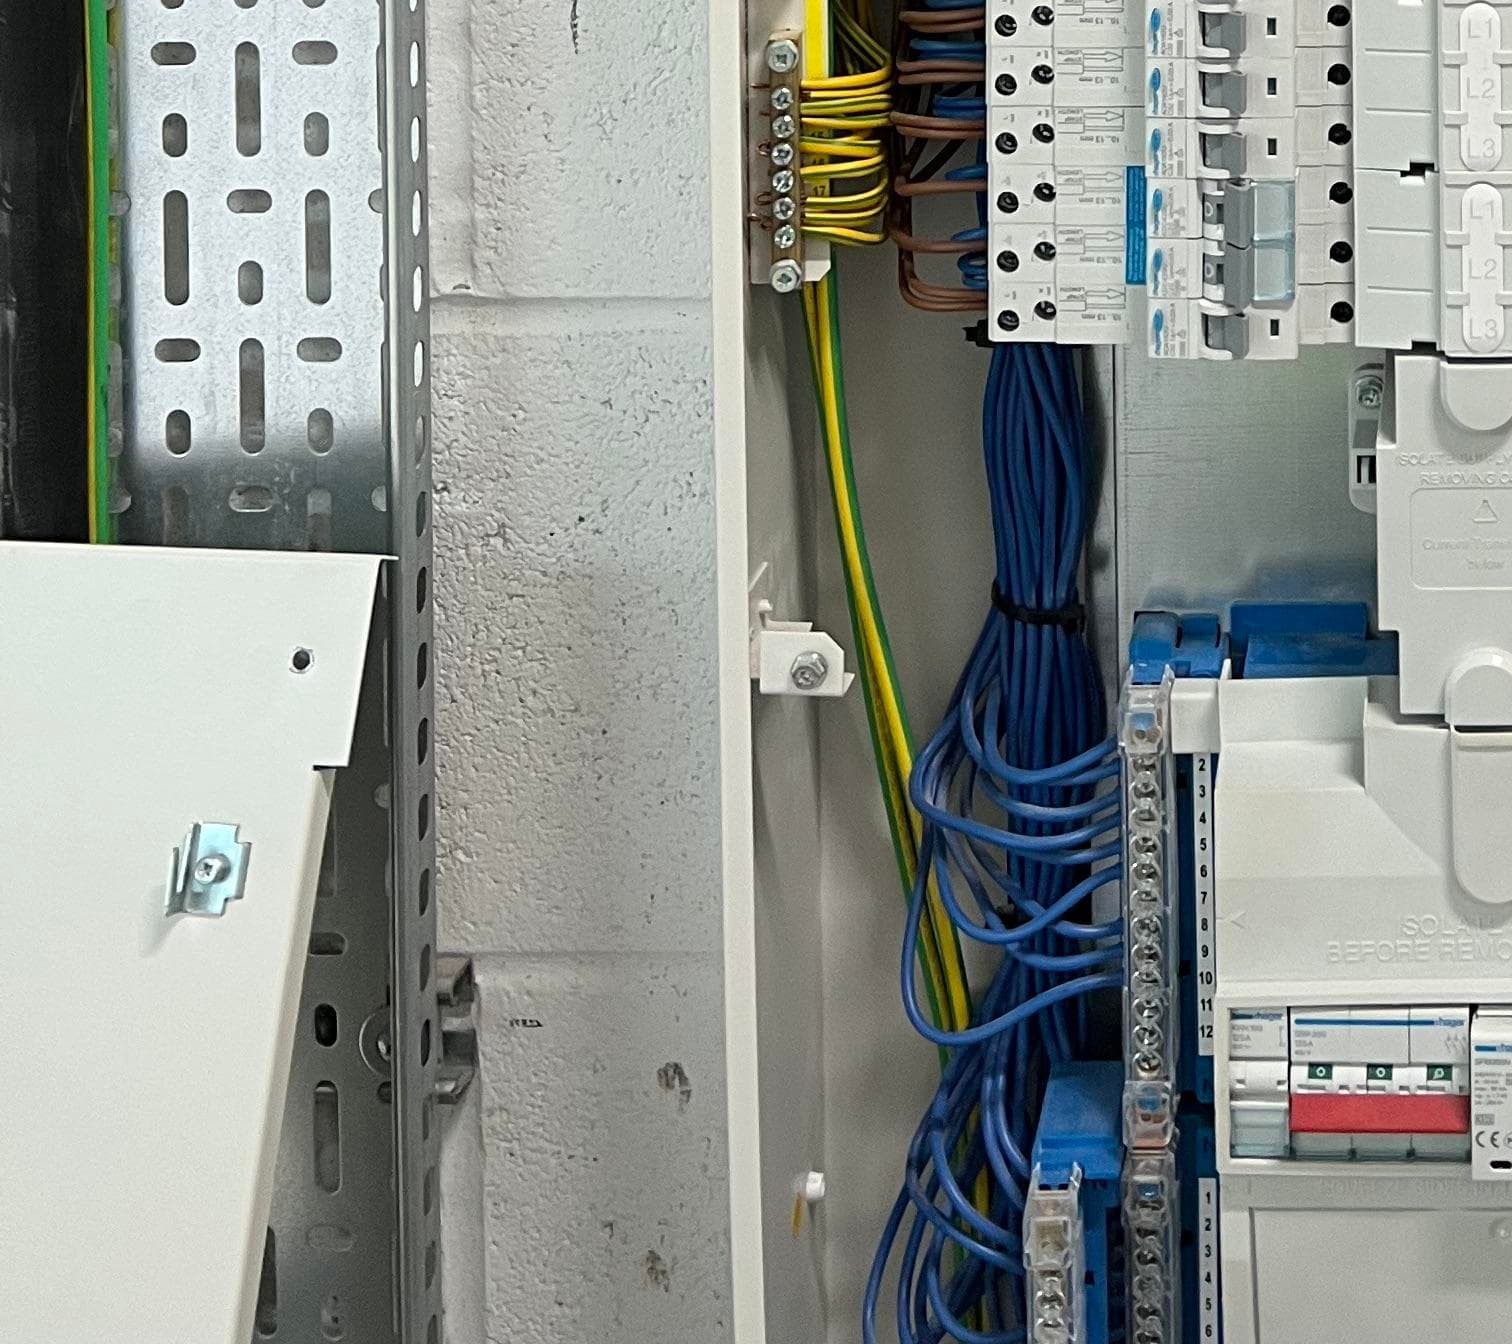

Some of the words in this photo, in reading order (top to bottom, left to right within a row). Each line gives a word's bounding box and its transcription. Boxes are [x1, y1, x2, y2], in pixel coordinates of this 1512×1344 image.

[1468, 18, 1492, 39] L1
[1466, 76, 1495, 98] L2
[1468, 136, 1495, 158] L3
[1470, 198, 1494, 219] L1
[1469, 258, 1497, 279] L2
[1470, 318, 1497, 340] L3
[1199, 759, 1206, 771] 2
[1199, 786, 1206, 797] 3
[1199, 812, 1206, 824] 4
[1200, 839, 1207, 851] 5
[1200, 865, 1207, 877] 6
[1200, 892, 1207, 904] 7
[1201, 919, 1208, 931] 8
[1201, 945, 1208, 957] 9
[1327, 939, 1430, 962] BEFORE
[1200, 972, 1213, 984] 10
[1200, 999, 1213, 1011] 11
[1200, 1025, 1213, 1038] 12
[1206, 1192, 1211, 1204] 1
[1205, 1219, 1211, 1231] 2
[1205, 1246, 1211, 1258] 3
[1205, 1272, 1212, 1284] 4
[1205, 1298, 1212, 1311] 5
[1205, 1325, 1212, 1337] 6
